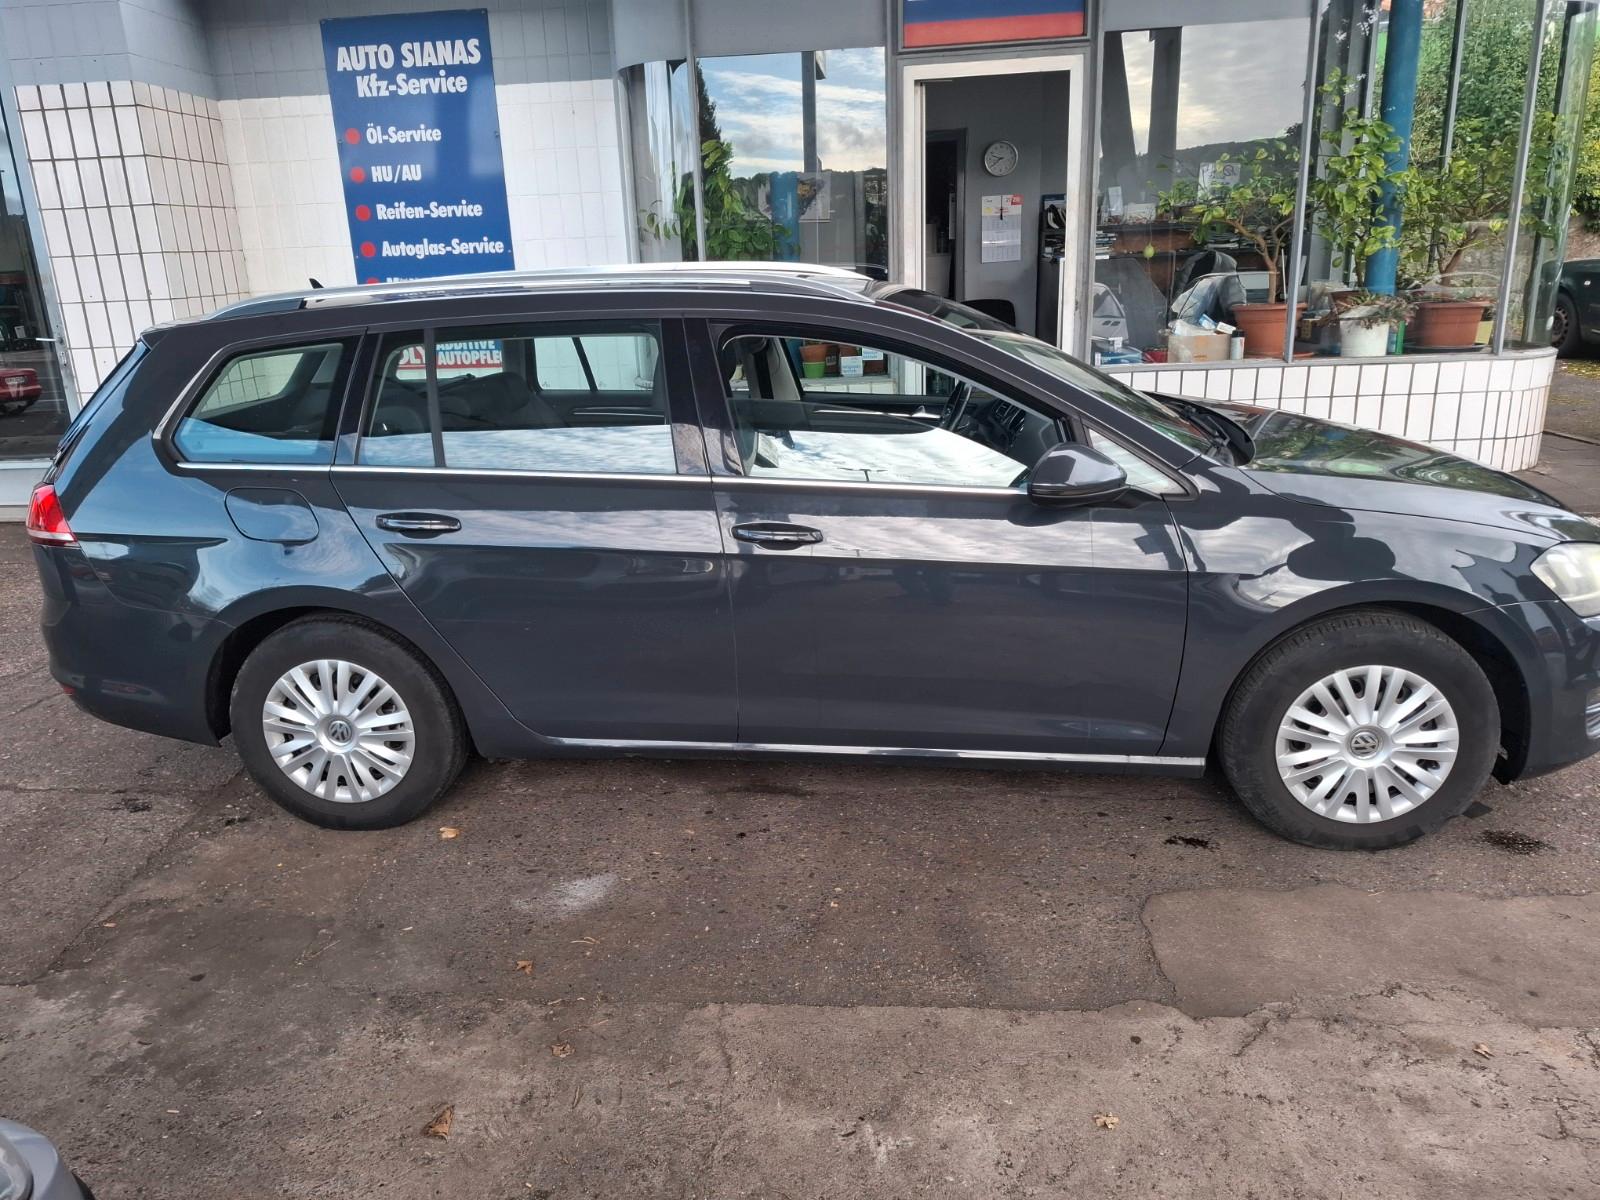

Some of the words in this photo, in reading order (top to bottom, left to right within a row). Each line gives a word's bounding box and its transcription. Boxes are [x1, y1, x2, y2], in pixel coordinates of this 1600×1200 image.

[337, 44, 394, 71] AUTO
[401, 38, 481, 68] SIANAS
[356, 70, 467, 97] Kfz-Service
[366, 123, 442, 144] Öl-Service
[371, 164, 422, 183] HU/AU
[376, 200, 483, 220] Reifen-Service
[382, 236, 505, 259] Autoglas-Service
[437, 350, 503, 365] AUTOPFLE
